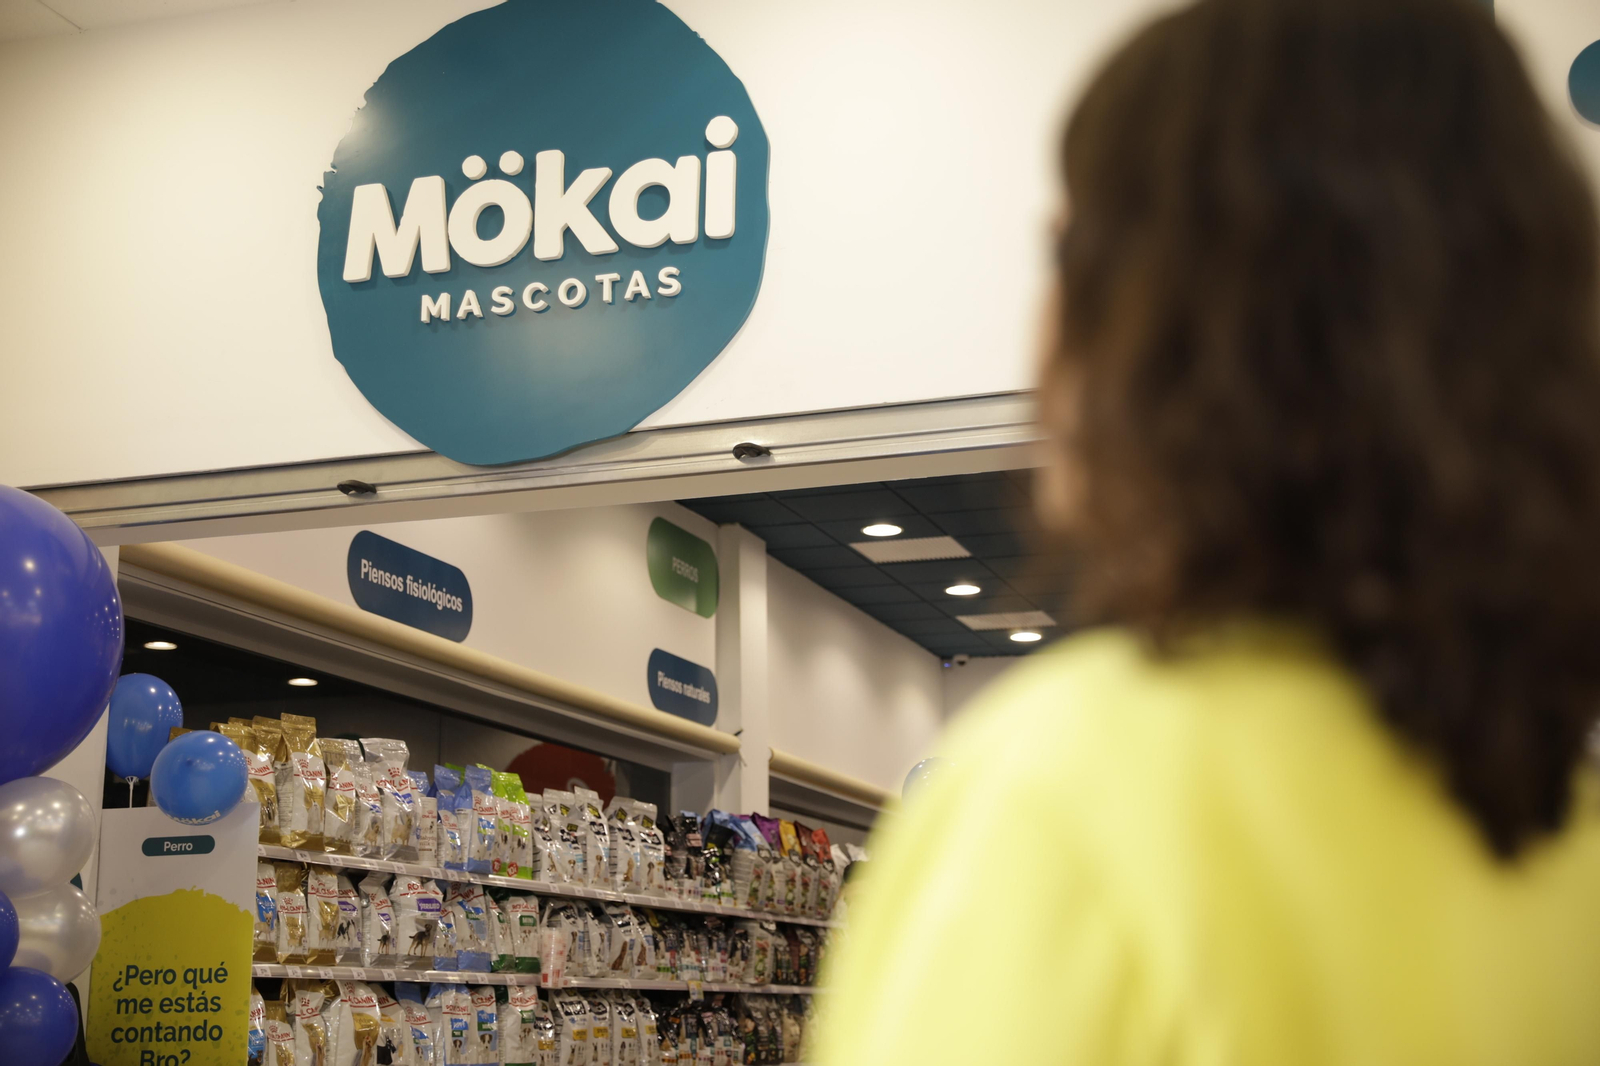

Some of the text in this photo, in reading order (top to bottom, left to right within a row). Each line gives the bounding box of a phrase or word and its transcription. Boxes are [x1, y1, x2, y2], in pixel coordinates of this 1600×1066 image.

[343, 115, 738, 283] Mökai
[420, 266, 682, 323] MASCOTAS
[672, 555, 699, 584] PERROS
[360, 557, 463, 613] Piensos fisiológicos
[657, 670, 711, 705] Piensos naturales
[163, 841, 193, 852] Perro
[113, 962, 229, 992] ¿Pero qué
[116, 991, 222, 1015] me estás
[111, 1020, 223, 1043] contando
[140, 1049, 191, 1066] Bro?
